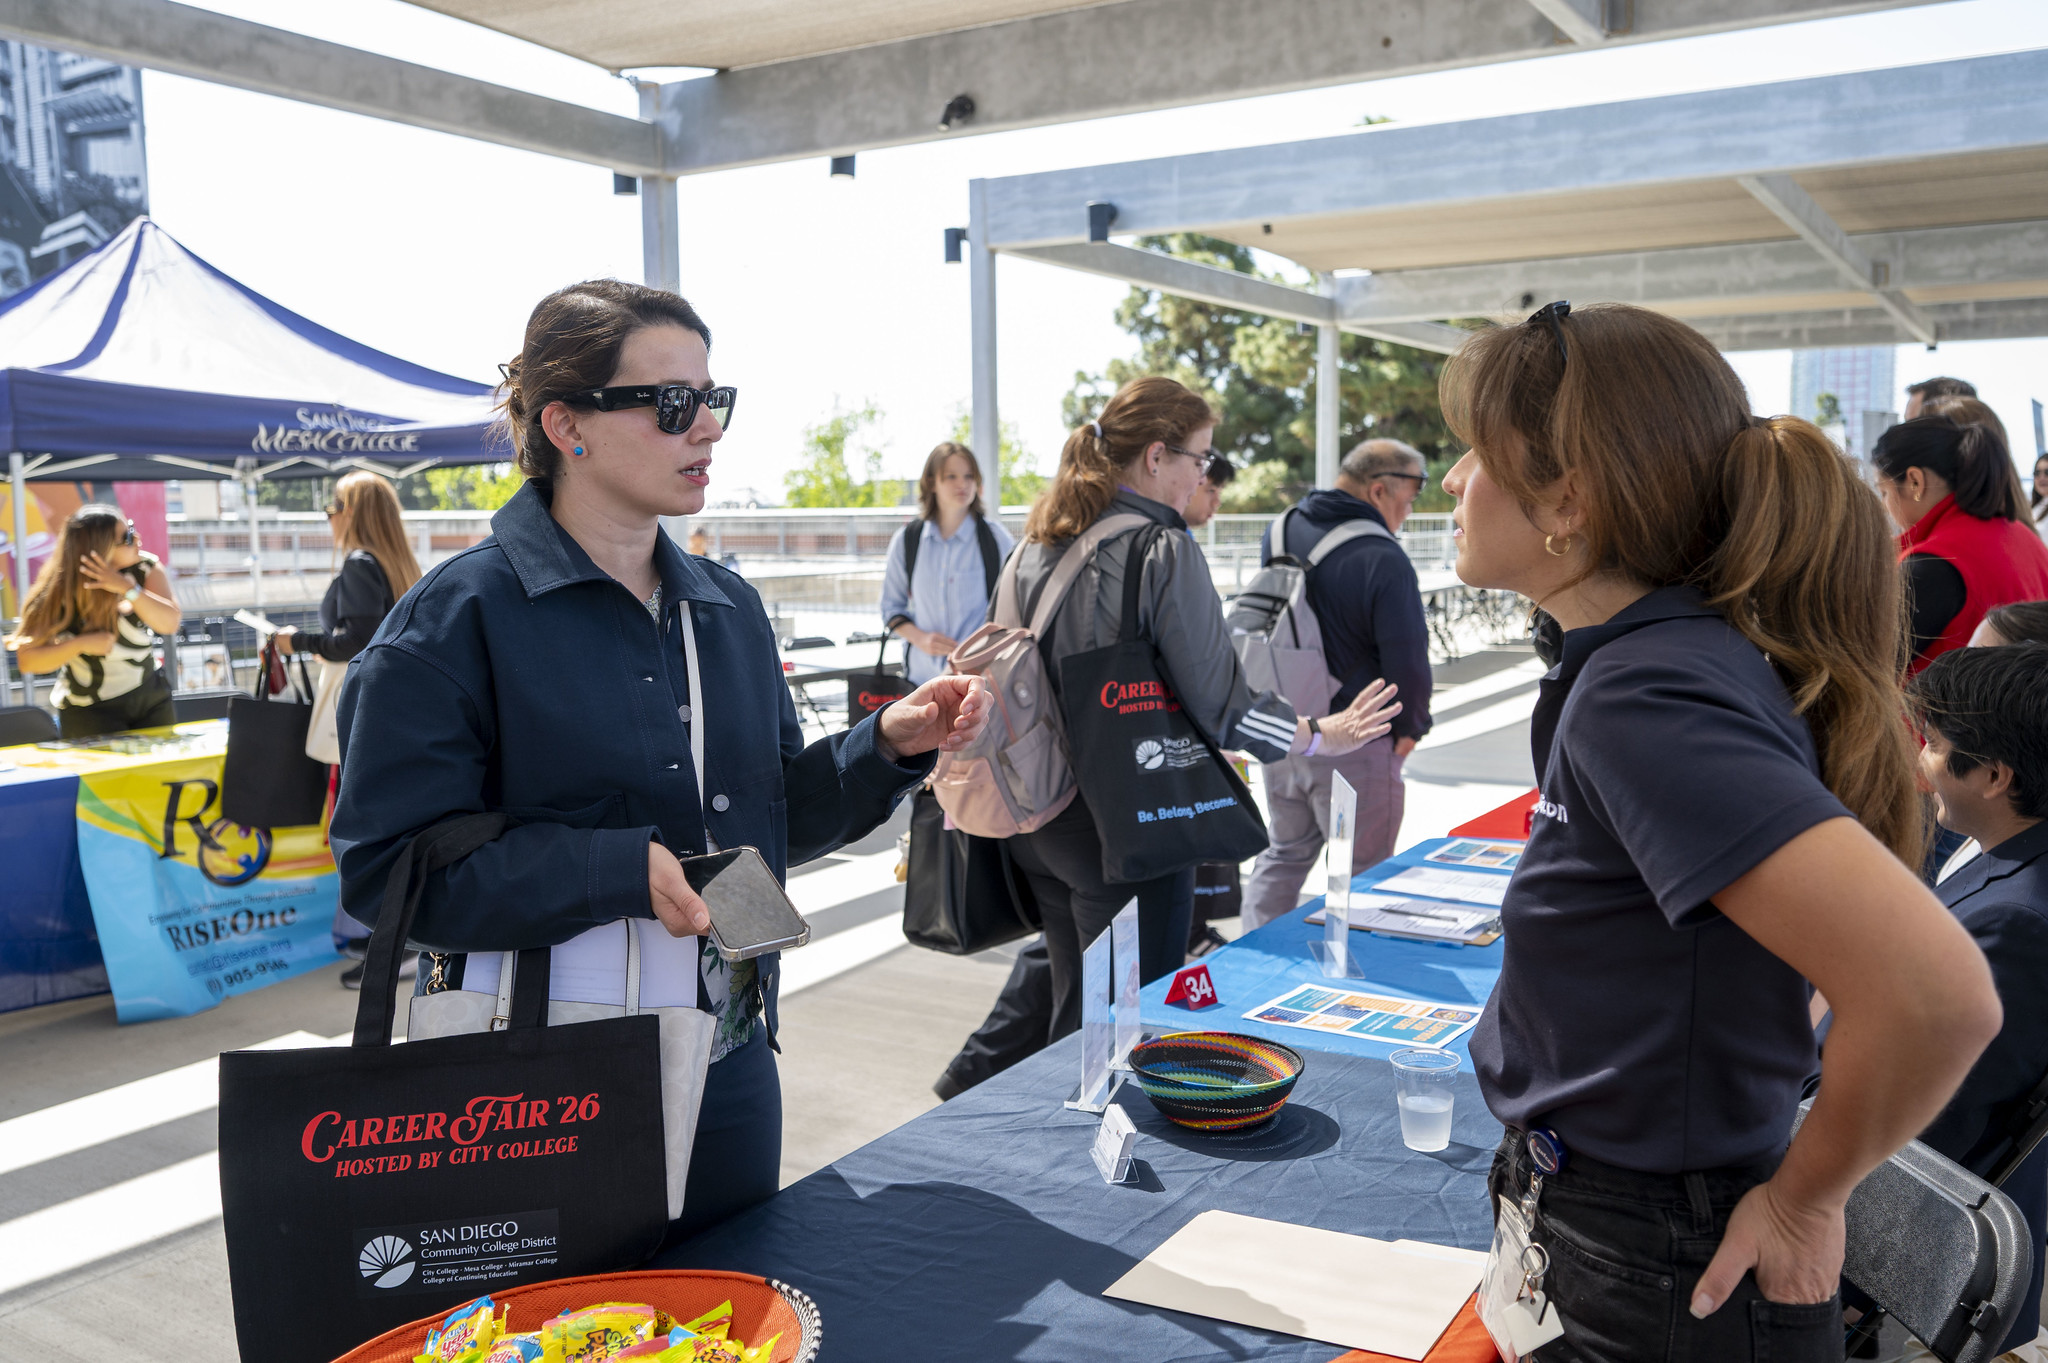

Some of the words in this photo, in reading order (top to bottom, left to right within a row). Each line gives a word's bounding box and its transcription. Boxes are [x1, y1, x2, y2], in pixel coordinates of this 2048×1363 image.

[1119, 701, 1155, 714] HOSTED
[1137, 810, 1157, 823] Be.
[1158, 805, 1195, 819] Belong.
[1194, 796, 1237, 814] Become.
[166, 905, 297, 952] RISEOne
[1186, 972, 1212, 1002] 34
[301, 1110, 447, 1163] CAREER
[450, 1092, 550, 1145] FAIR
[556, 1093, 600, 1124] '26
[335, 1154, 411, 1178] HOSTED
[418, 1151, 442, 1169] BY
[448, 1145, 494, 1165] CITY
[497, 1136, 578, 1160] COLLEGE
[420, 1228, 455, 1245] SAN
[460, 1221, 518, 1240] DIEGO
[421, 1243, 479, 1259] Community
[481, 1240, 518, 1253] College
[522, 1236, 556, 1249] District
[423, 1277, 445, 1285] College
[454, 1272, 487, 1282] Continuing
[488, 1270, 518, 1279] Education
[436, 1267, 459, 1275] College
[509, 1260, 534, 1268] Miramar
[535, 1257, 558, 1265] College
